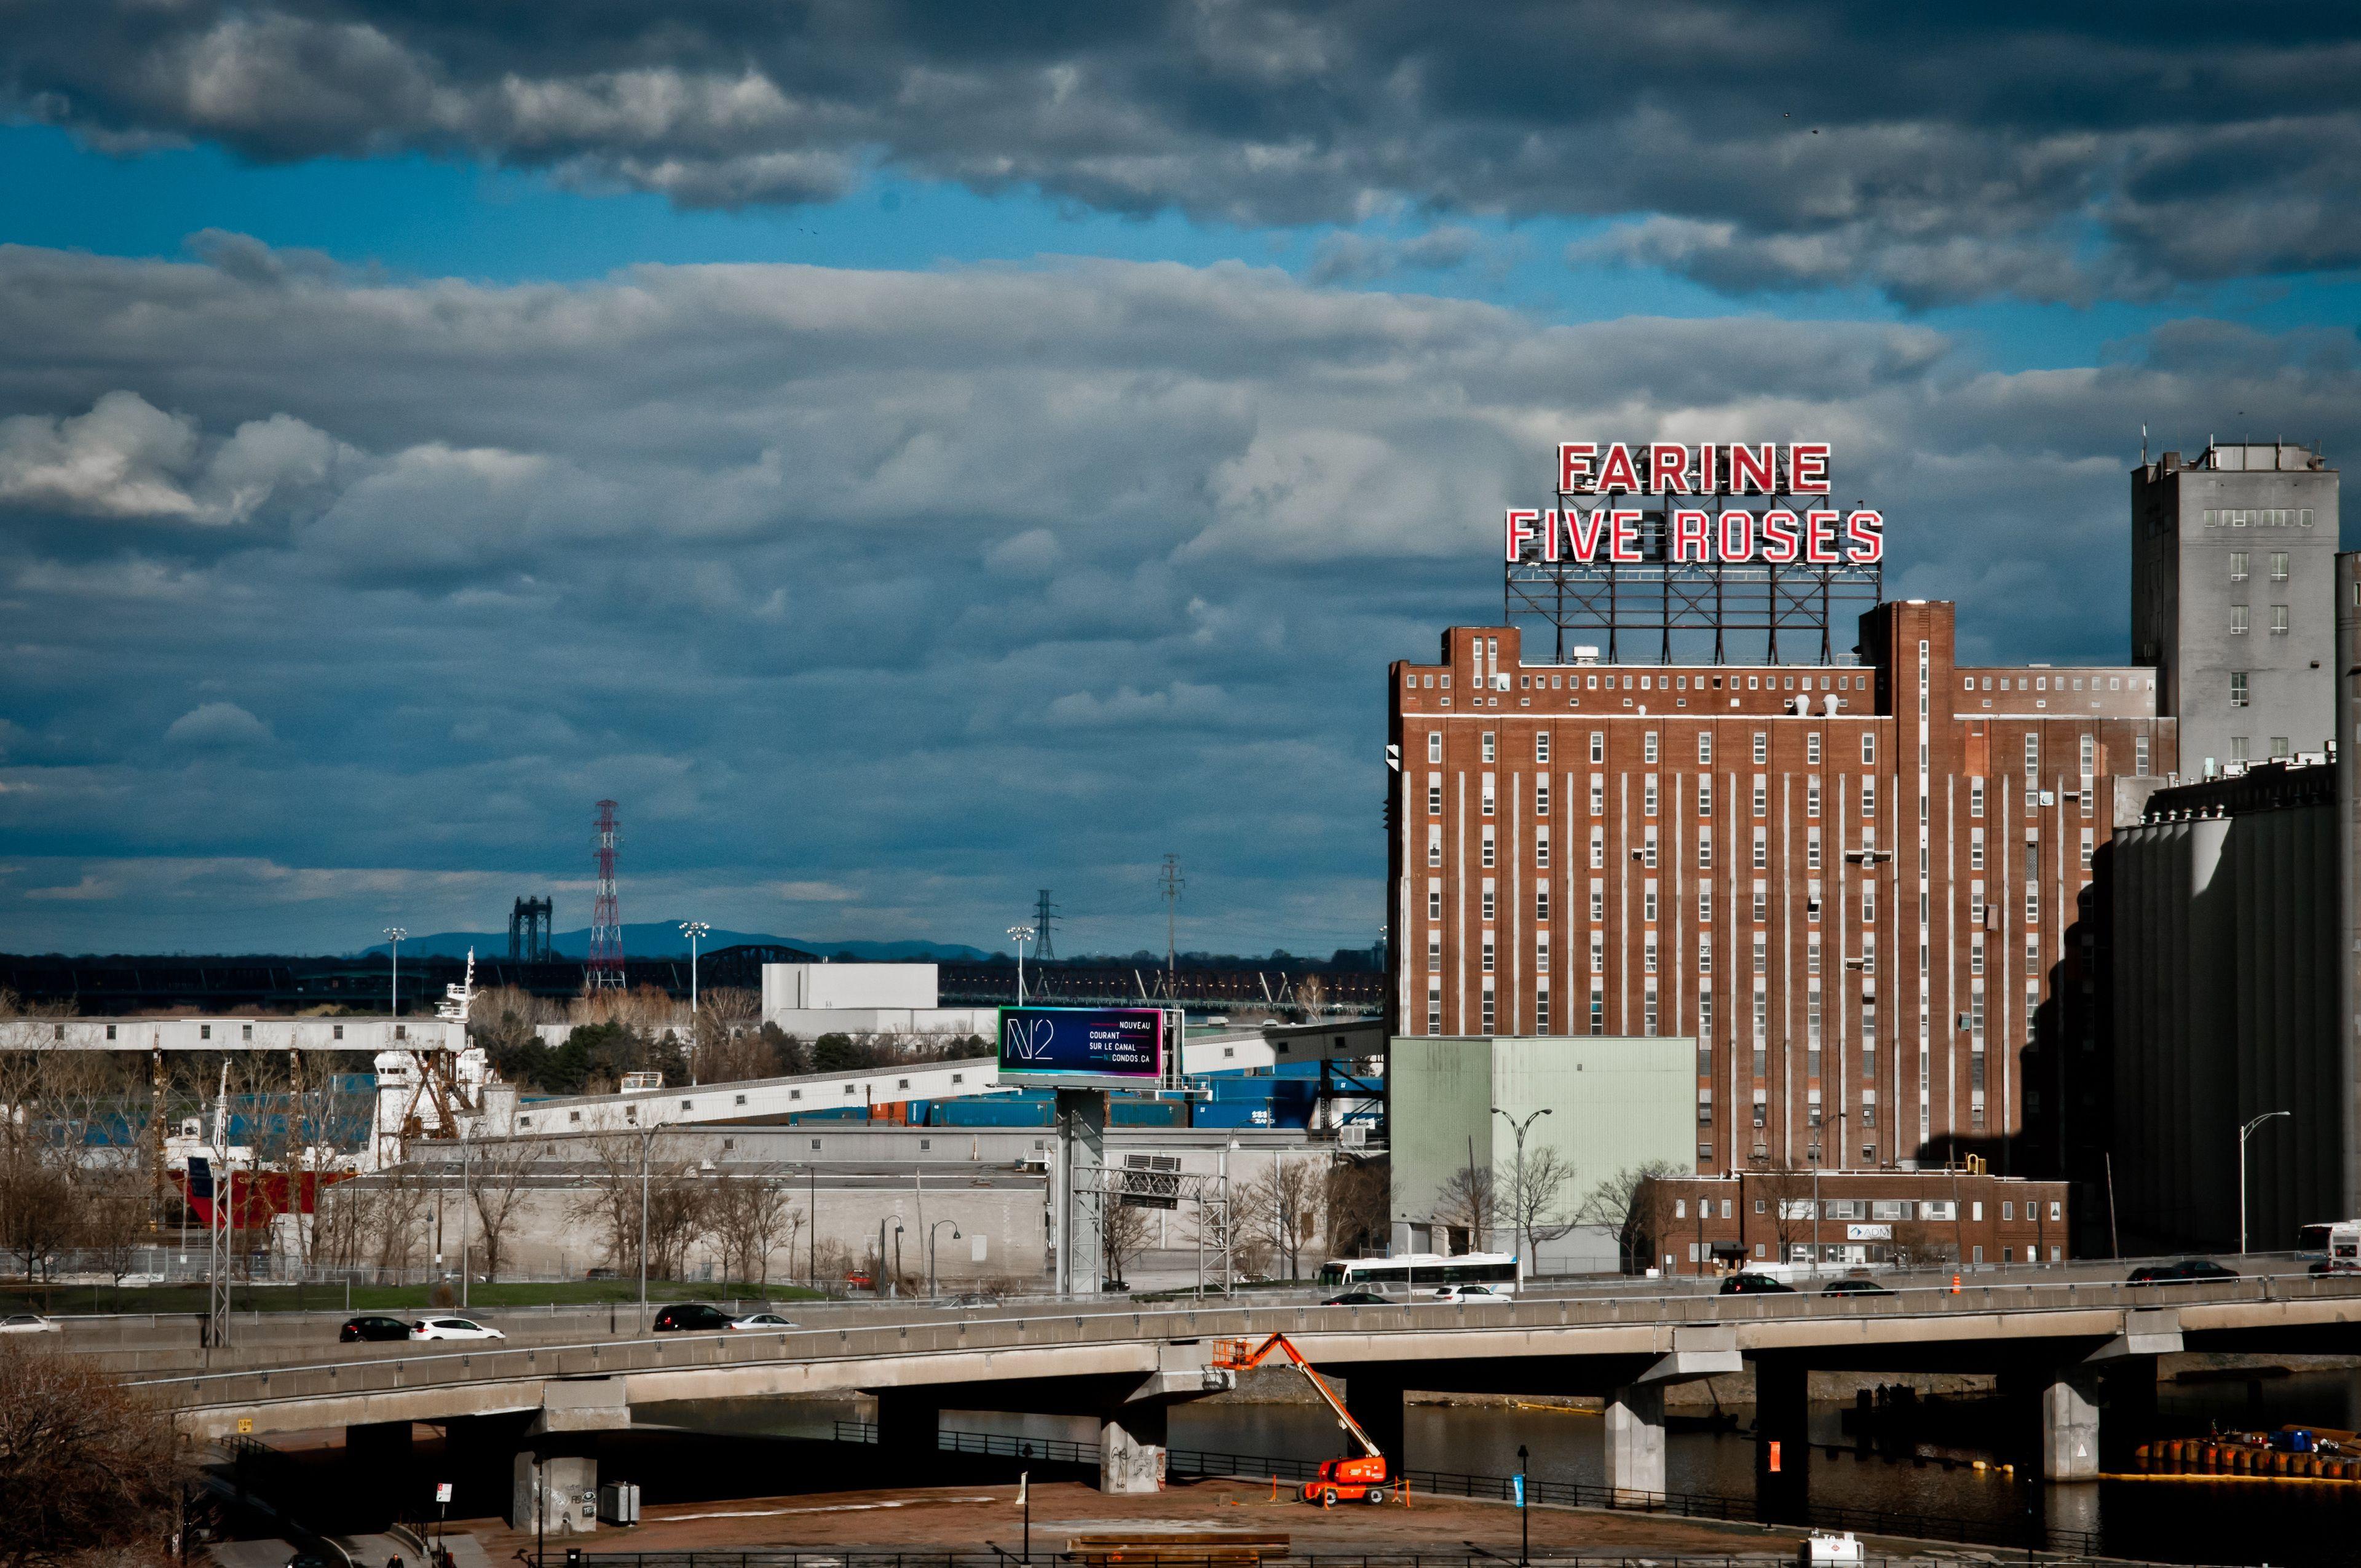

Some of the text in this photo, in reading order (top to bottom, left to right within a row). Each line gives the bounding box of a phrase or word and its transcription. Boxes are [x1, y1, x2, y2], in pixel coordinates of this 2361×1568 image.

[1560, 442, 1831, 494] FARINE
[1506, 509, 1883, 563] FIVE ROSES
[1007, 1019, 1053, 1059] N2
